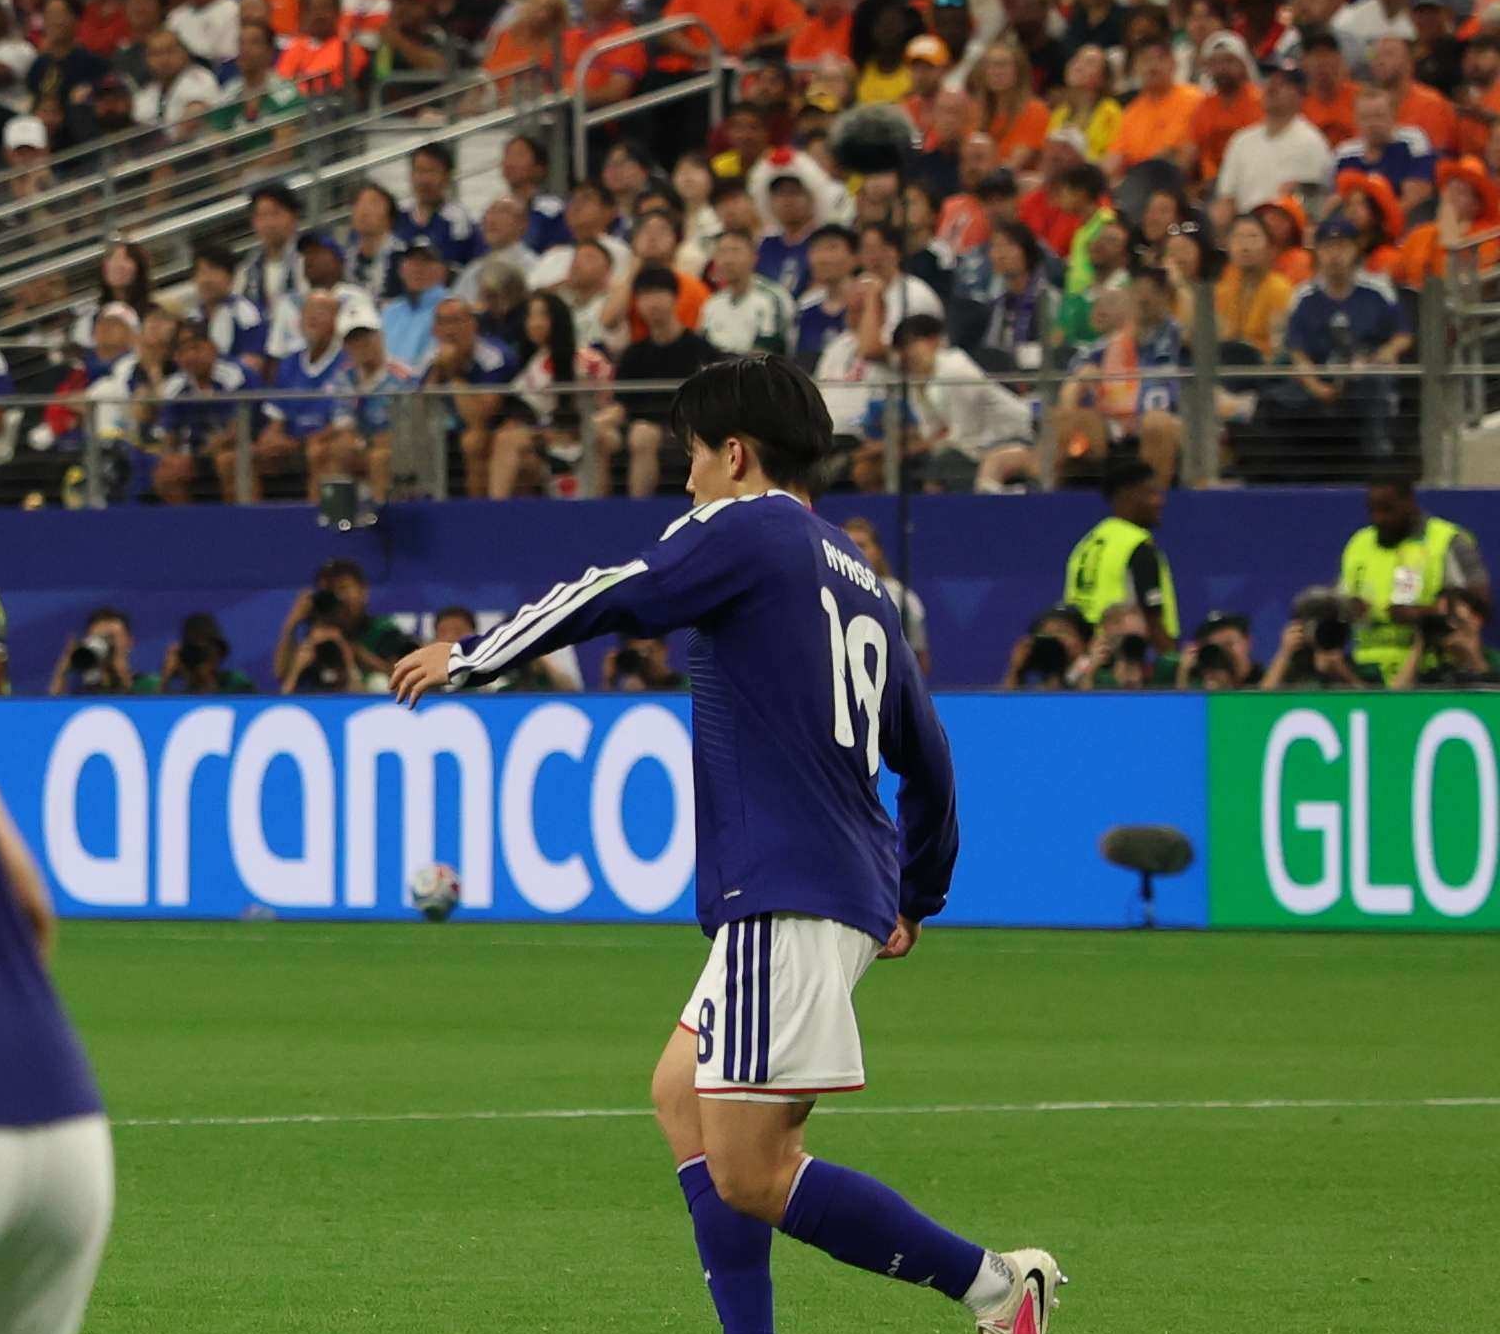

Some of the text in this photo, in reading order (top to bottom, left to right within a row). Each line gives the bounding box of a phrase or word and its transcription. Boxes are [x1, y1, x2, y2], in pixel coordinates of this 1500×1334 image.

[821, 537, 883, 600] AYASE
[42, 701, 698, 915] aramco
[1261, 708, 1500, 917] GLO
